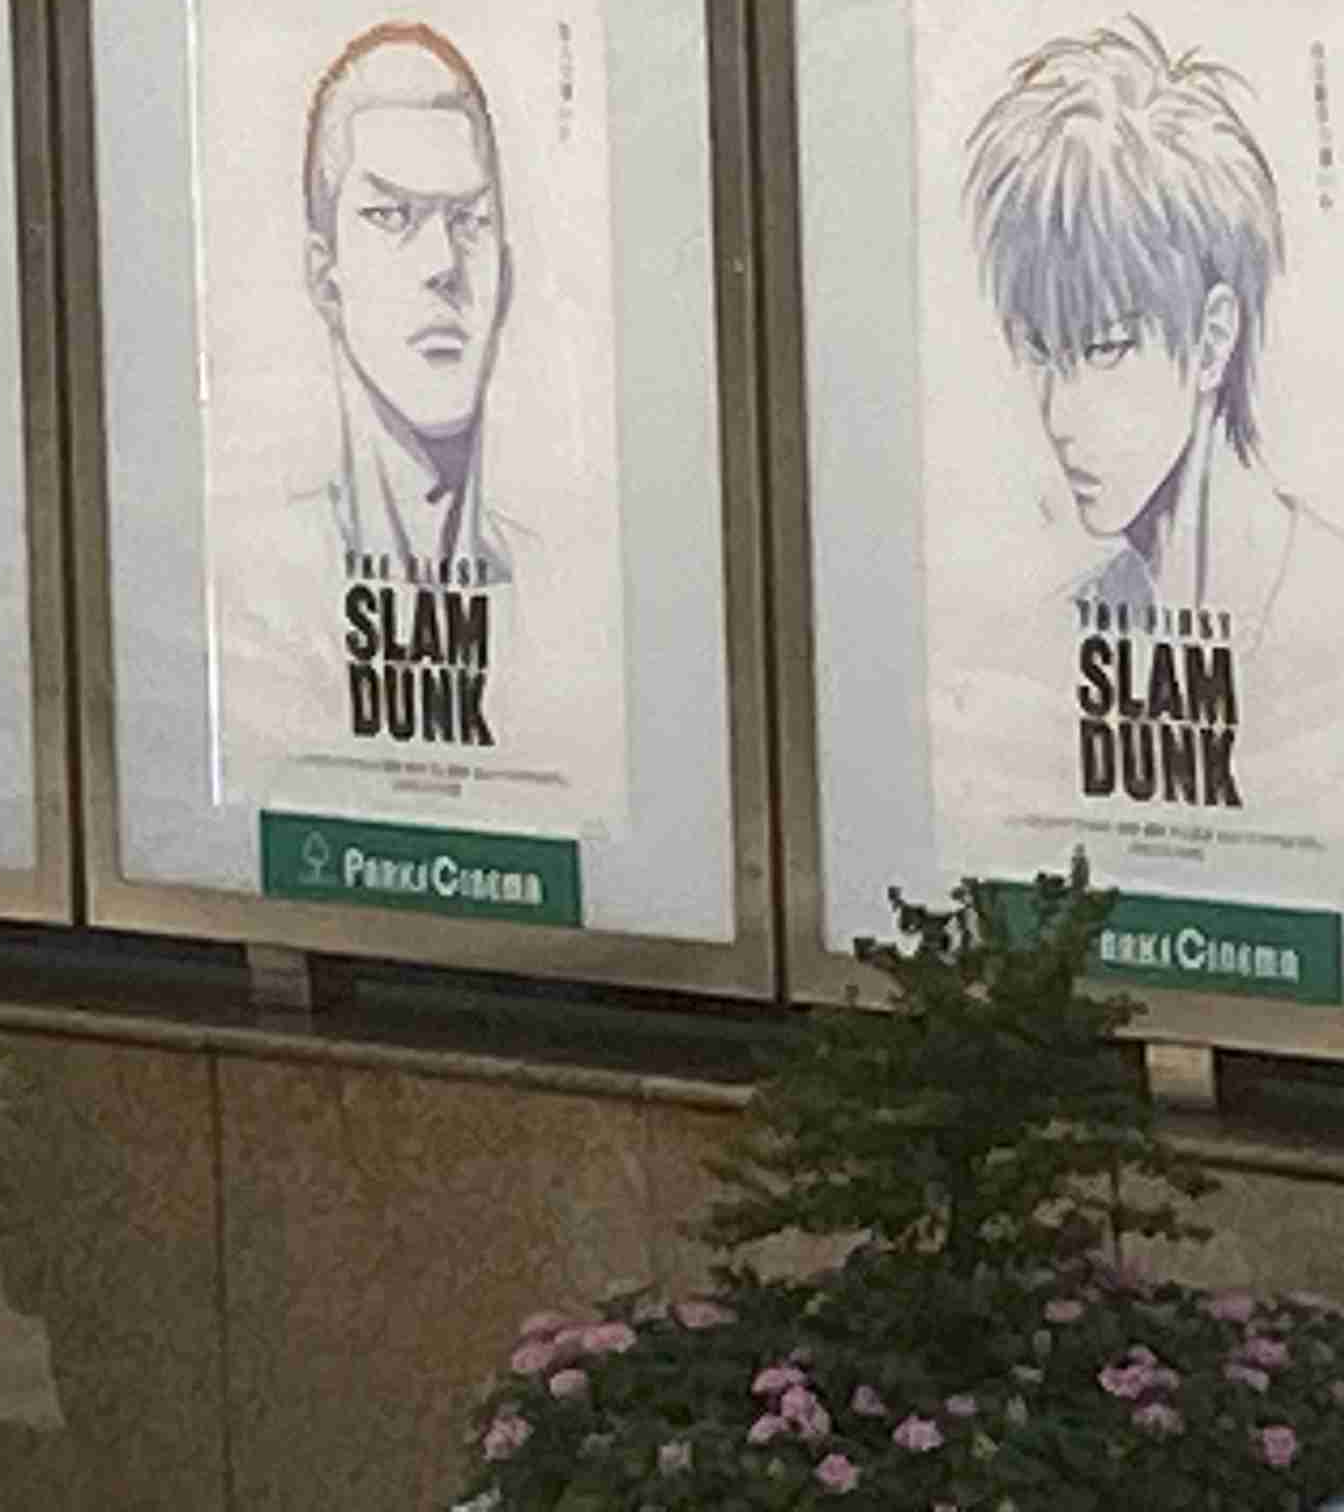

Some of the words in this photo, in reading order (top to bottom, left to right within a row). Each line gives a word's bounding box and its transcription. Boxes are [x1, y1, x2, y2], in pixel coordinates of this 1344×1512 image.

[345, 584, 490, 670] SLAM
[348, 660, 496, 747] DUNK
[1076, 633, 1239, 726] SLAM
[1079, 717, 1244, 809] DUNK
